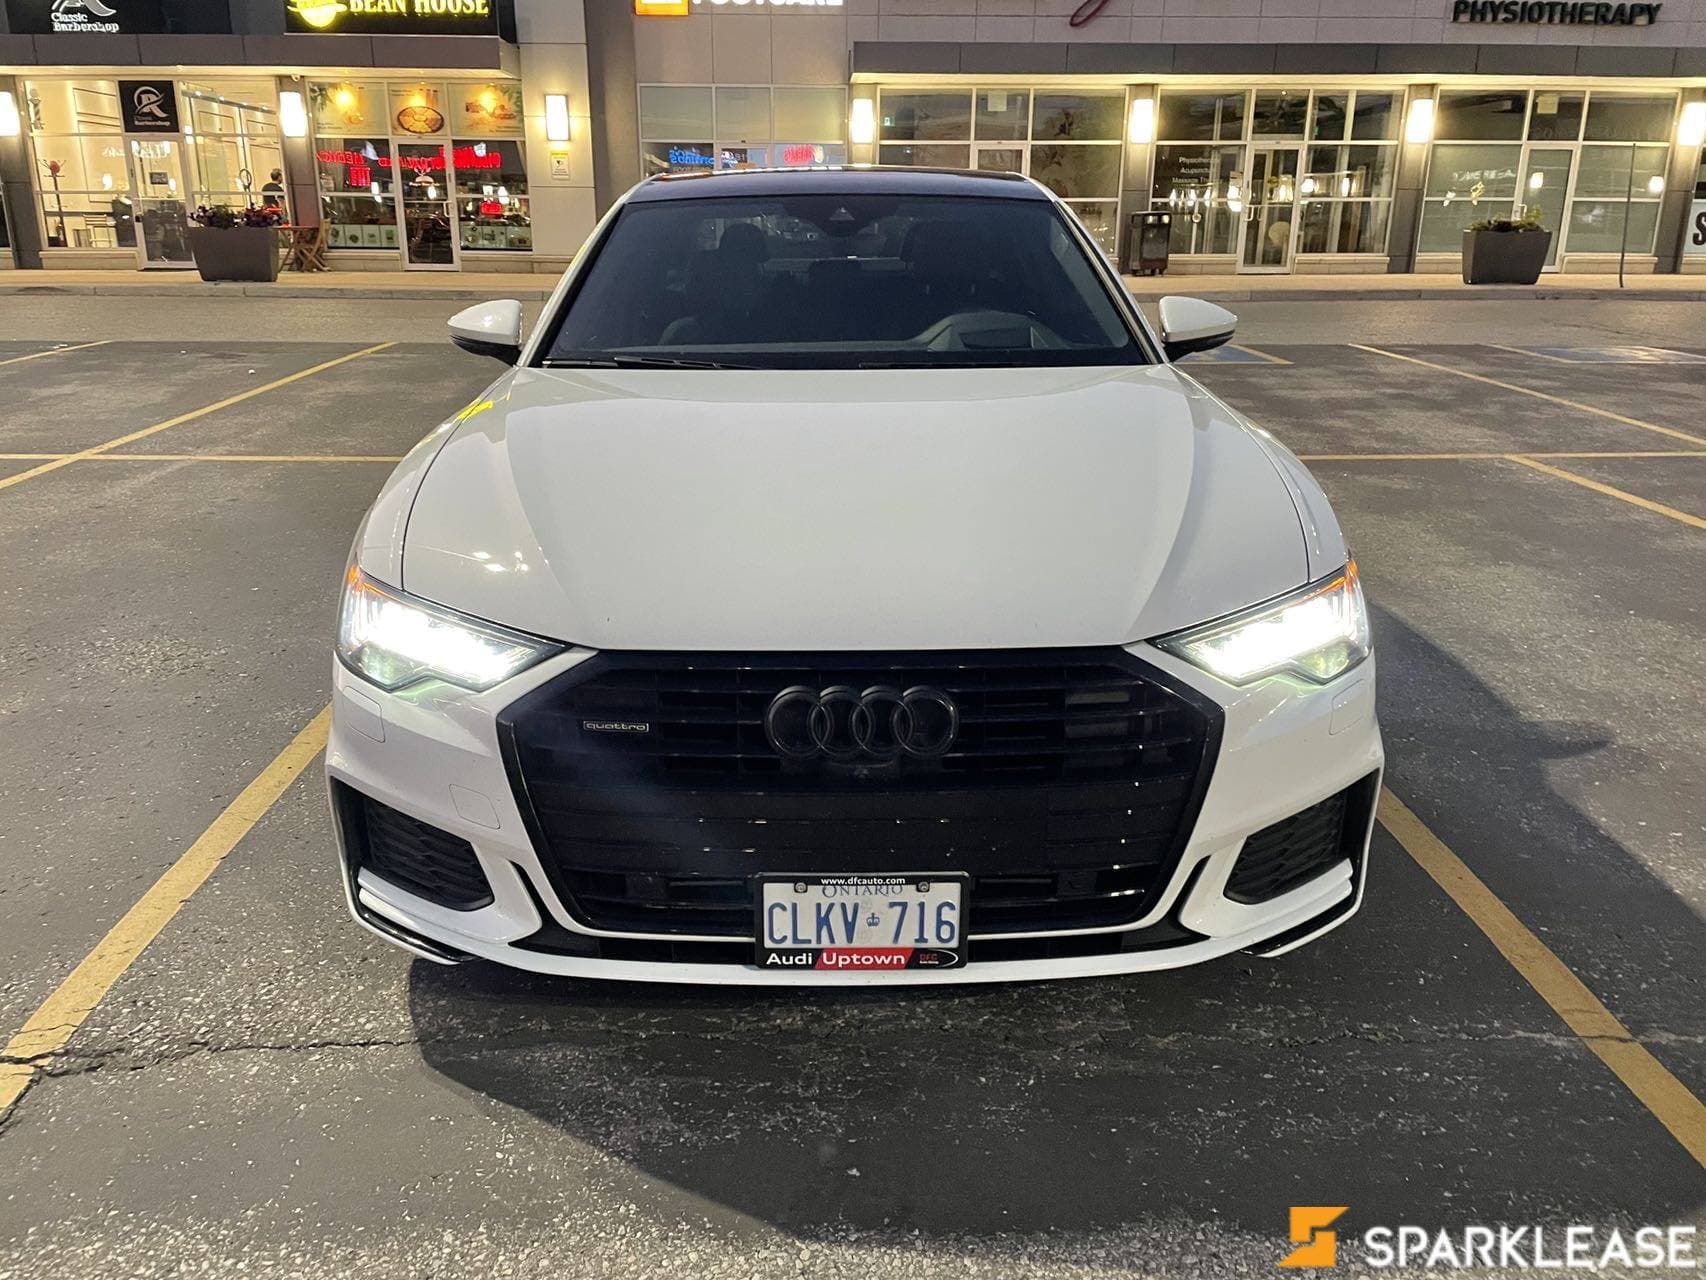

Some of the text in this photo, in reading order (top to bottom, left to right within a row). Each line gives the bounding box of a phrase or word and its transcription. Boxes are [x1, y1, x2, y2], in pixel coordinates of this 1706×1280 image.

[51, 12, 88, 22] Classic
[1452, 1, 1663, 25] PHYSIOTHERAPY
[53, 22, 119, 32] Barbershop
[586, 723, 646, 731] quattro
[821, 877, 906, 885] www.dfcauto.com
[822, 884, 903, 898] ONTARIO
[768, 901, 956, 944] CLKV 716
[766, 953, 905, 967] Audi Uptown
